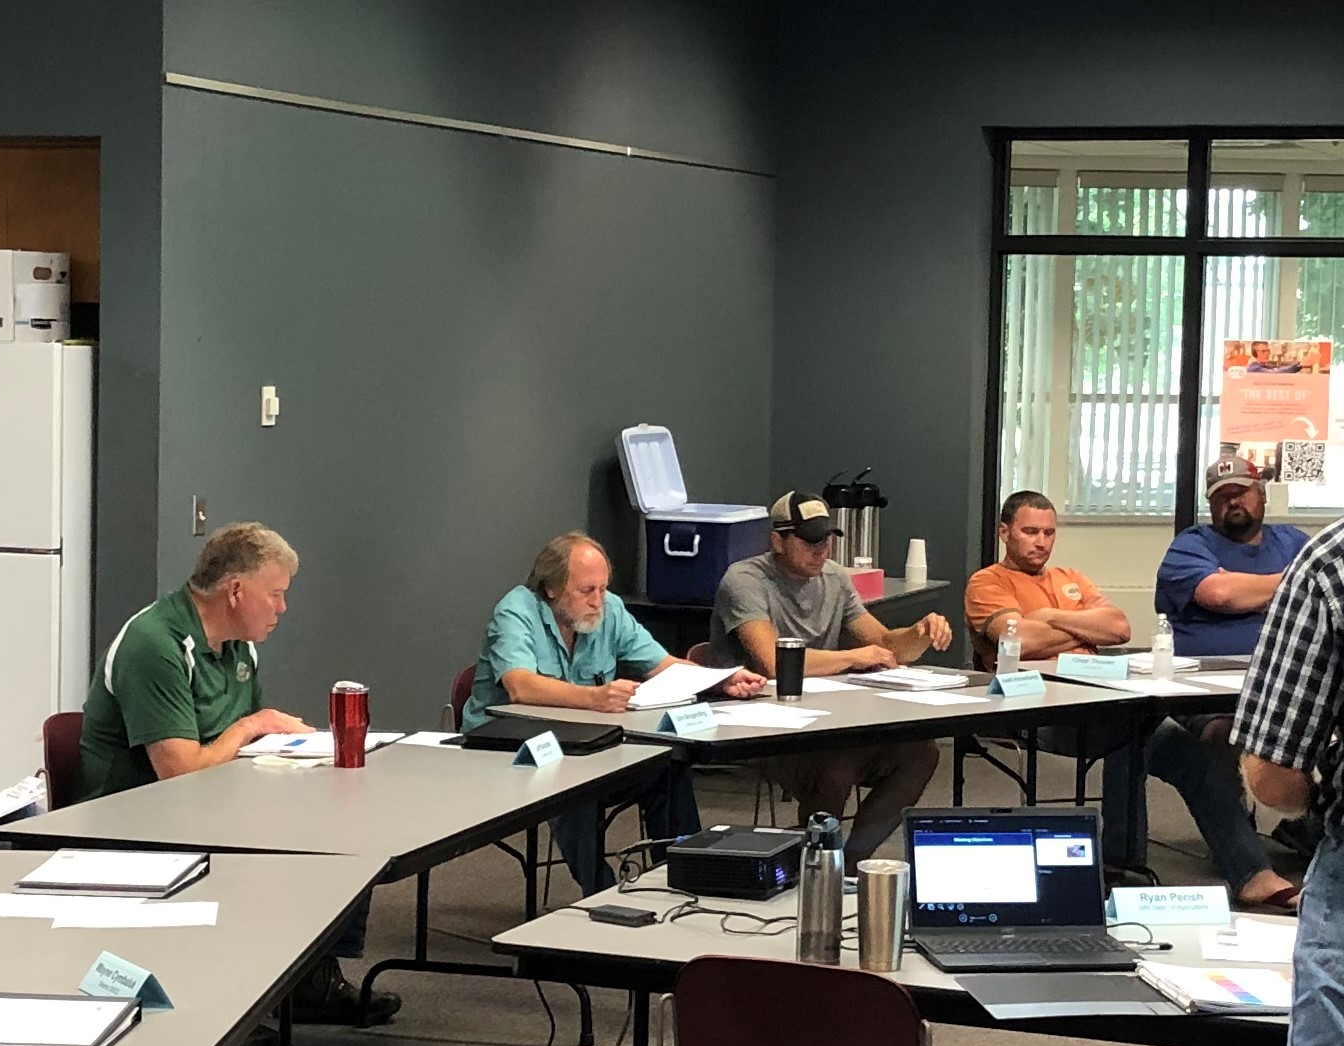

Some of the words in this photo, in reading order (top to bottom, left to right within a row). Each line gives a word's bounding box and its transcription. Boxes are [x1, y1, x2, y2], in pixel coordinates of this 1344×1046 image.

[1266, 389, 1291, 400] BEST
[1139, 892, 1167, 904] Ryan
[1169, 892, 1204, 902] Perish
